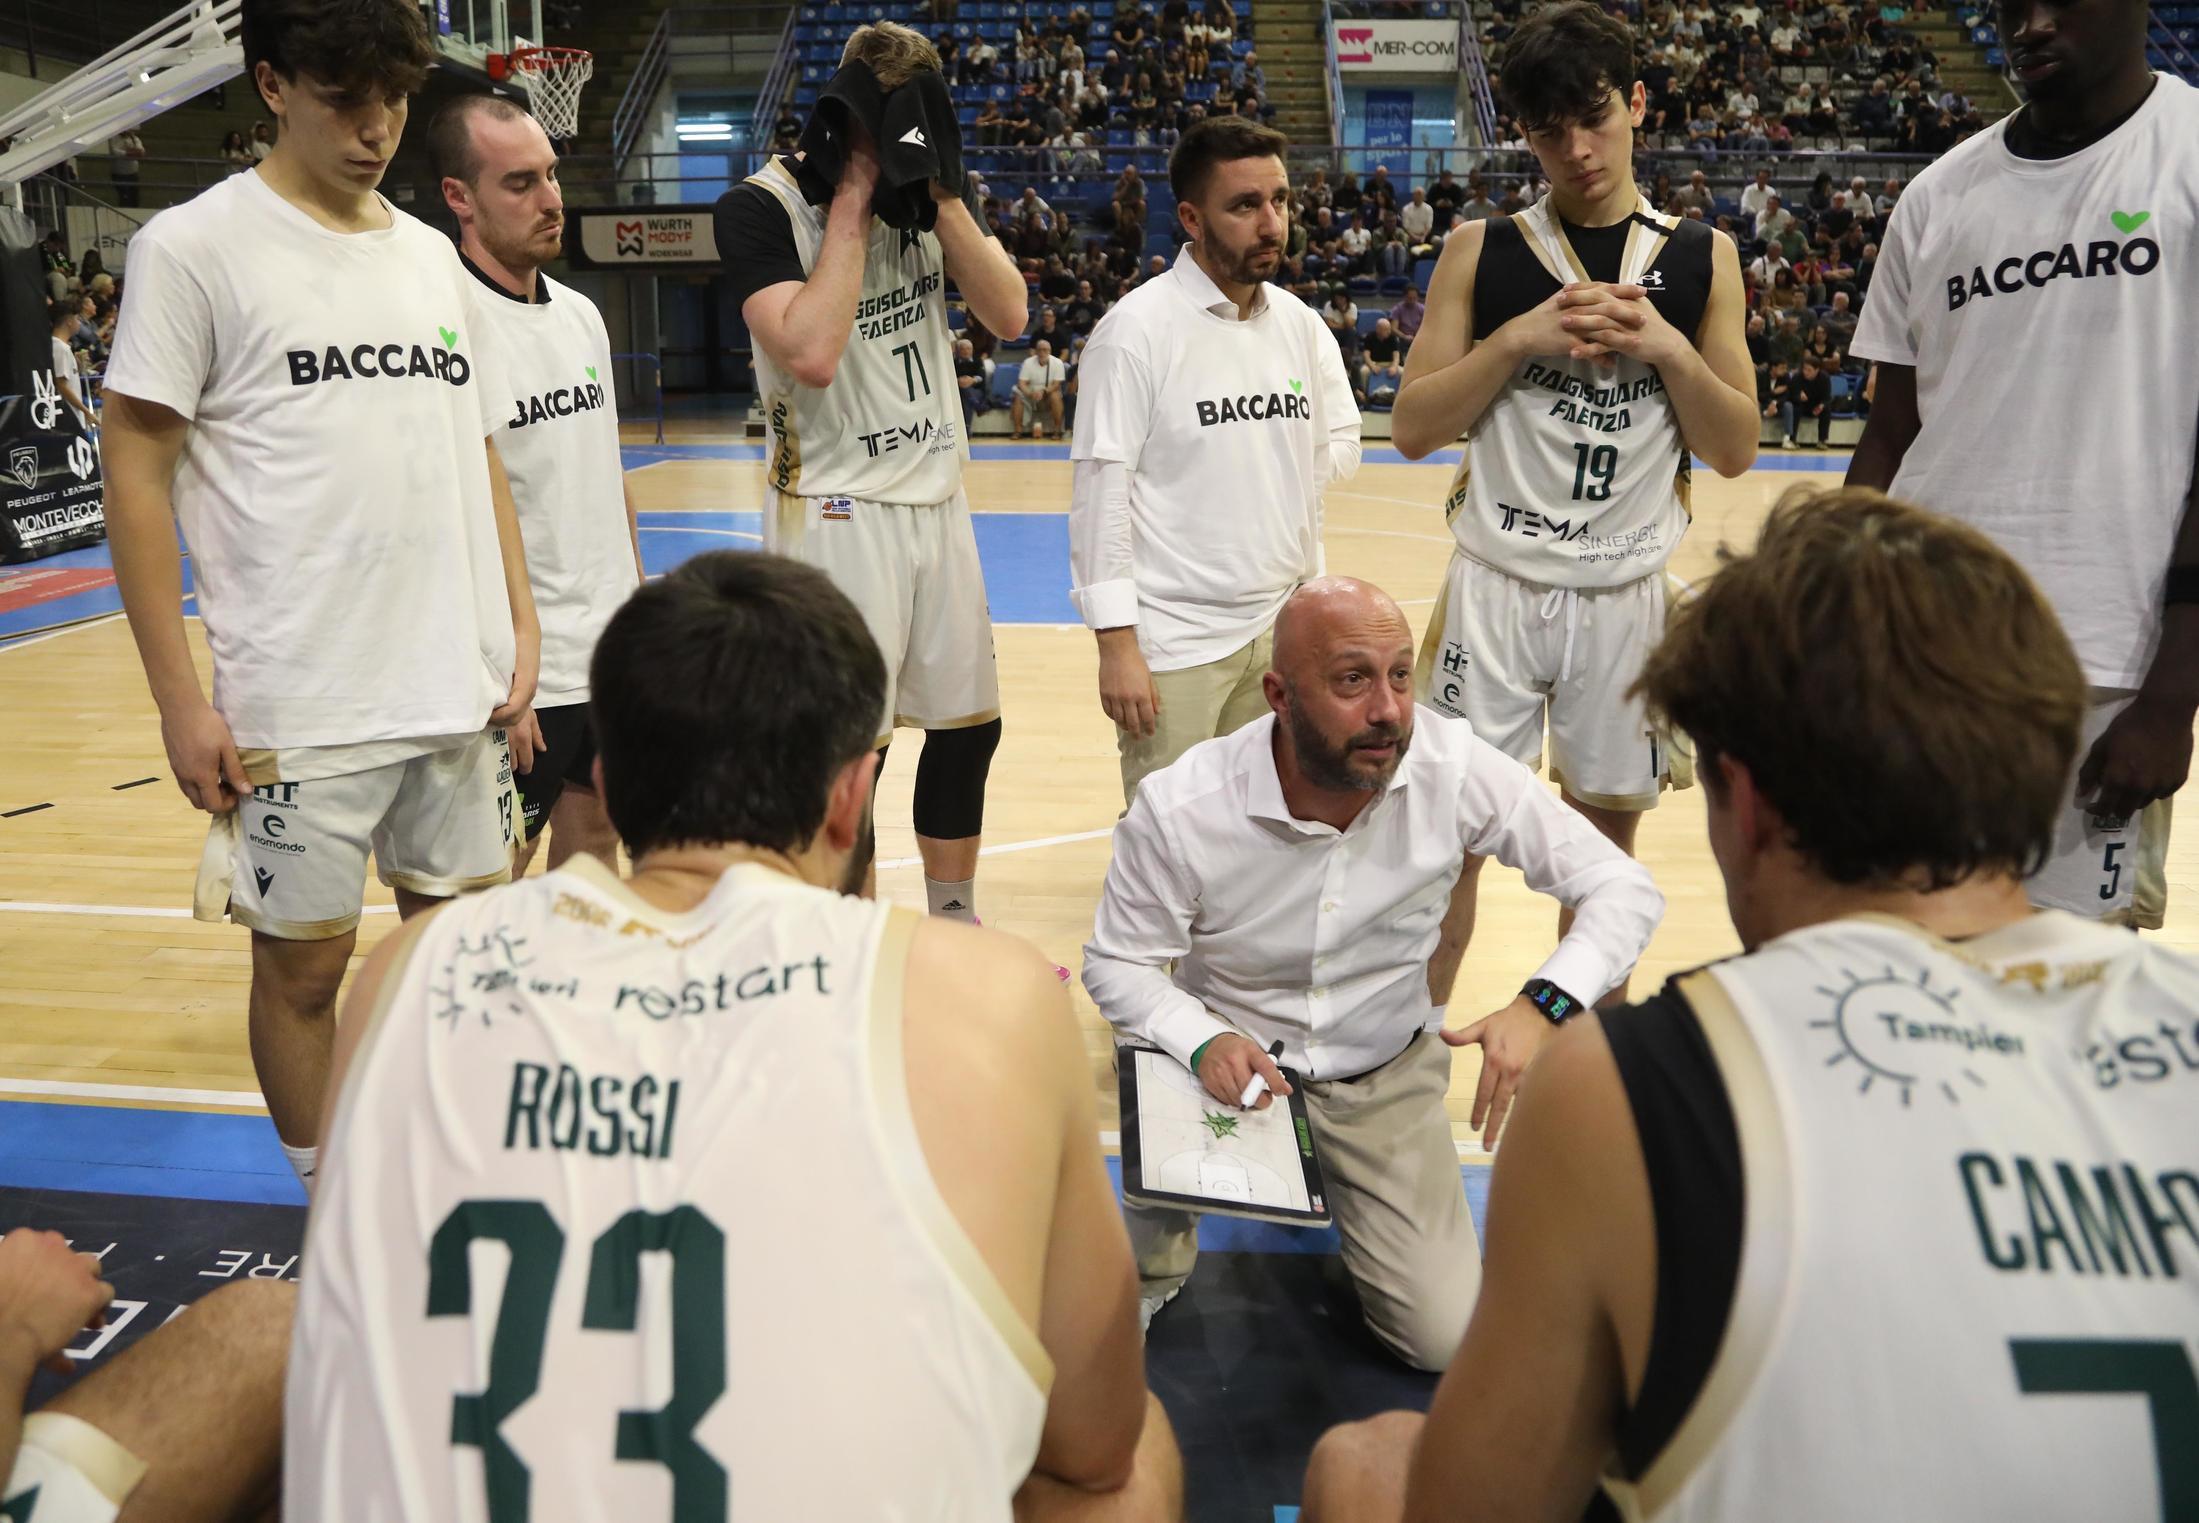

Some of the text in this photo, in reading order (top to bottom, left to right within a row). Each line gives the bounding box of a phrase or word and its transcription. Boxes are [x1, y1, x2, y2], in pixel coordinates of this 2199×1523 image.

[1373, 40, 1455, 56] MER-COM
[1946, 237, 2161, 312] BACCARO
[858, 302, 926, 341] FAENZA
[286, 343, 471, 387] BACCARO
[891, 340, 931, 402] 71
[507, 383, 605, 430] BACCARO
[1195, 392, 1311, 427] BACCARO
[1548, 398, 1632, 433] FAENZA
[857, 416, 934, 458] TEMA
[1571, 442, 1619, 502] 19
[7, 491, 57, 509] PEUGEOT
[1497, 502, 1590, 542] TEMA
[1579, 552, 1602, 564] High
[249, 833, 306, 853] enomondo
[2099, 842, 2126, 900] 5
[613, 954, 831, 1021] restart
[504, 1061, 682, 1160] ROSSI
[426, 1200, 728, 1523] 33
